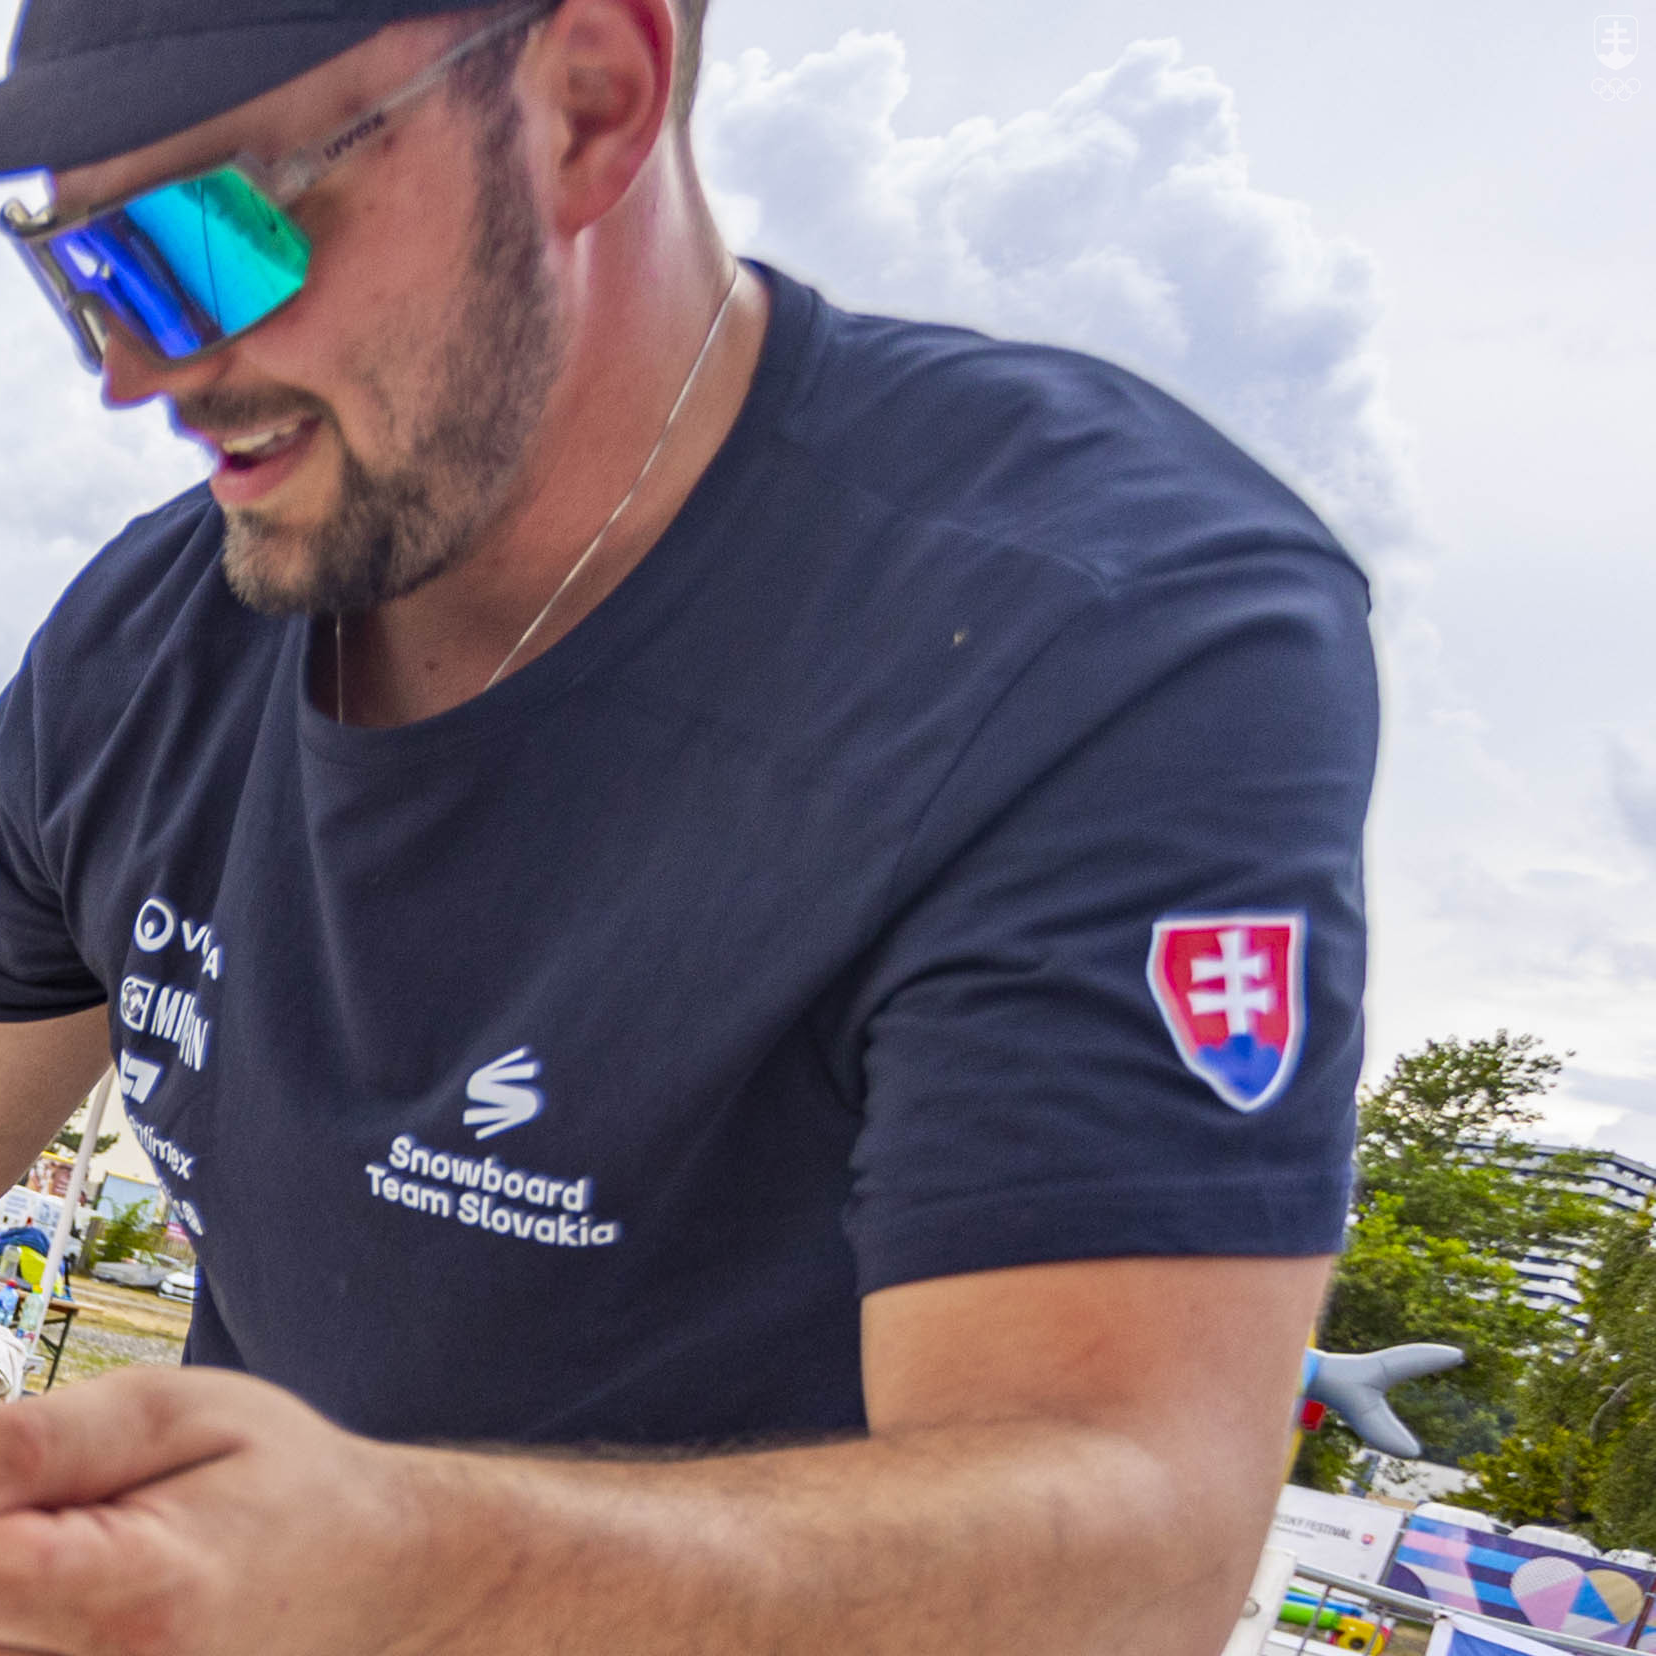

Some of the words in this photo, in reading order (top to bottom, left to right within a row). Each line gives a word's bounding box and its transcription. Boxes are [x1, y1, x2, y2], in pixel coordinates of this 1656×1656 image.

[365, 1163, 452, 1219] Team
[457, 1191, 620, 1248] Slovakia
[388, 1134, 588, 1213] Snowboard
